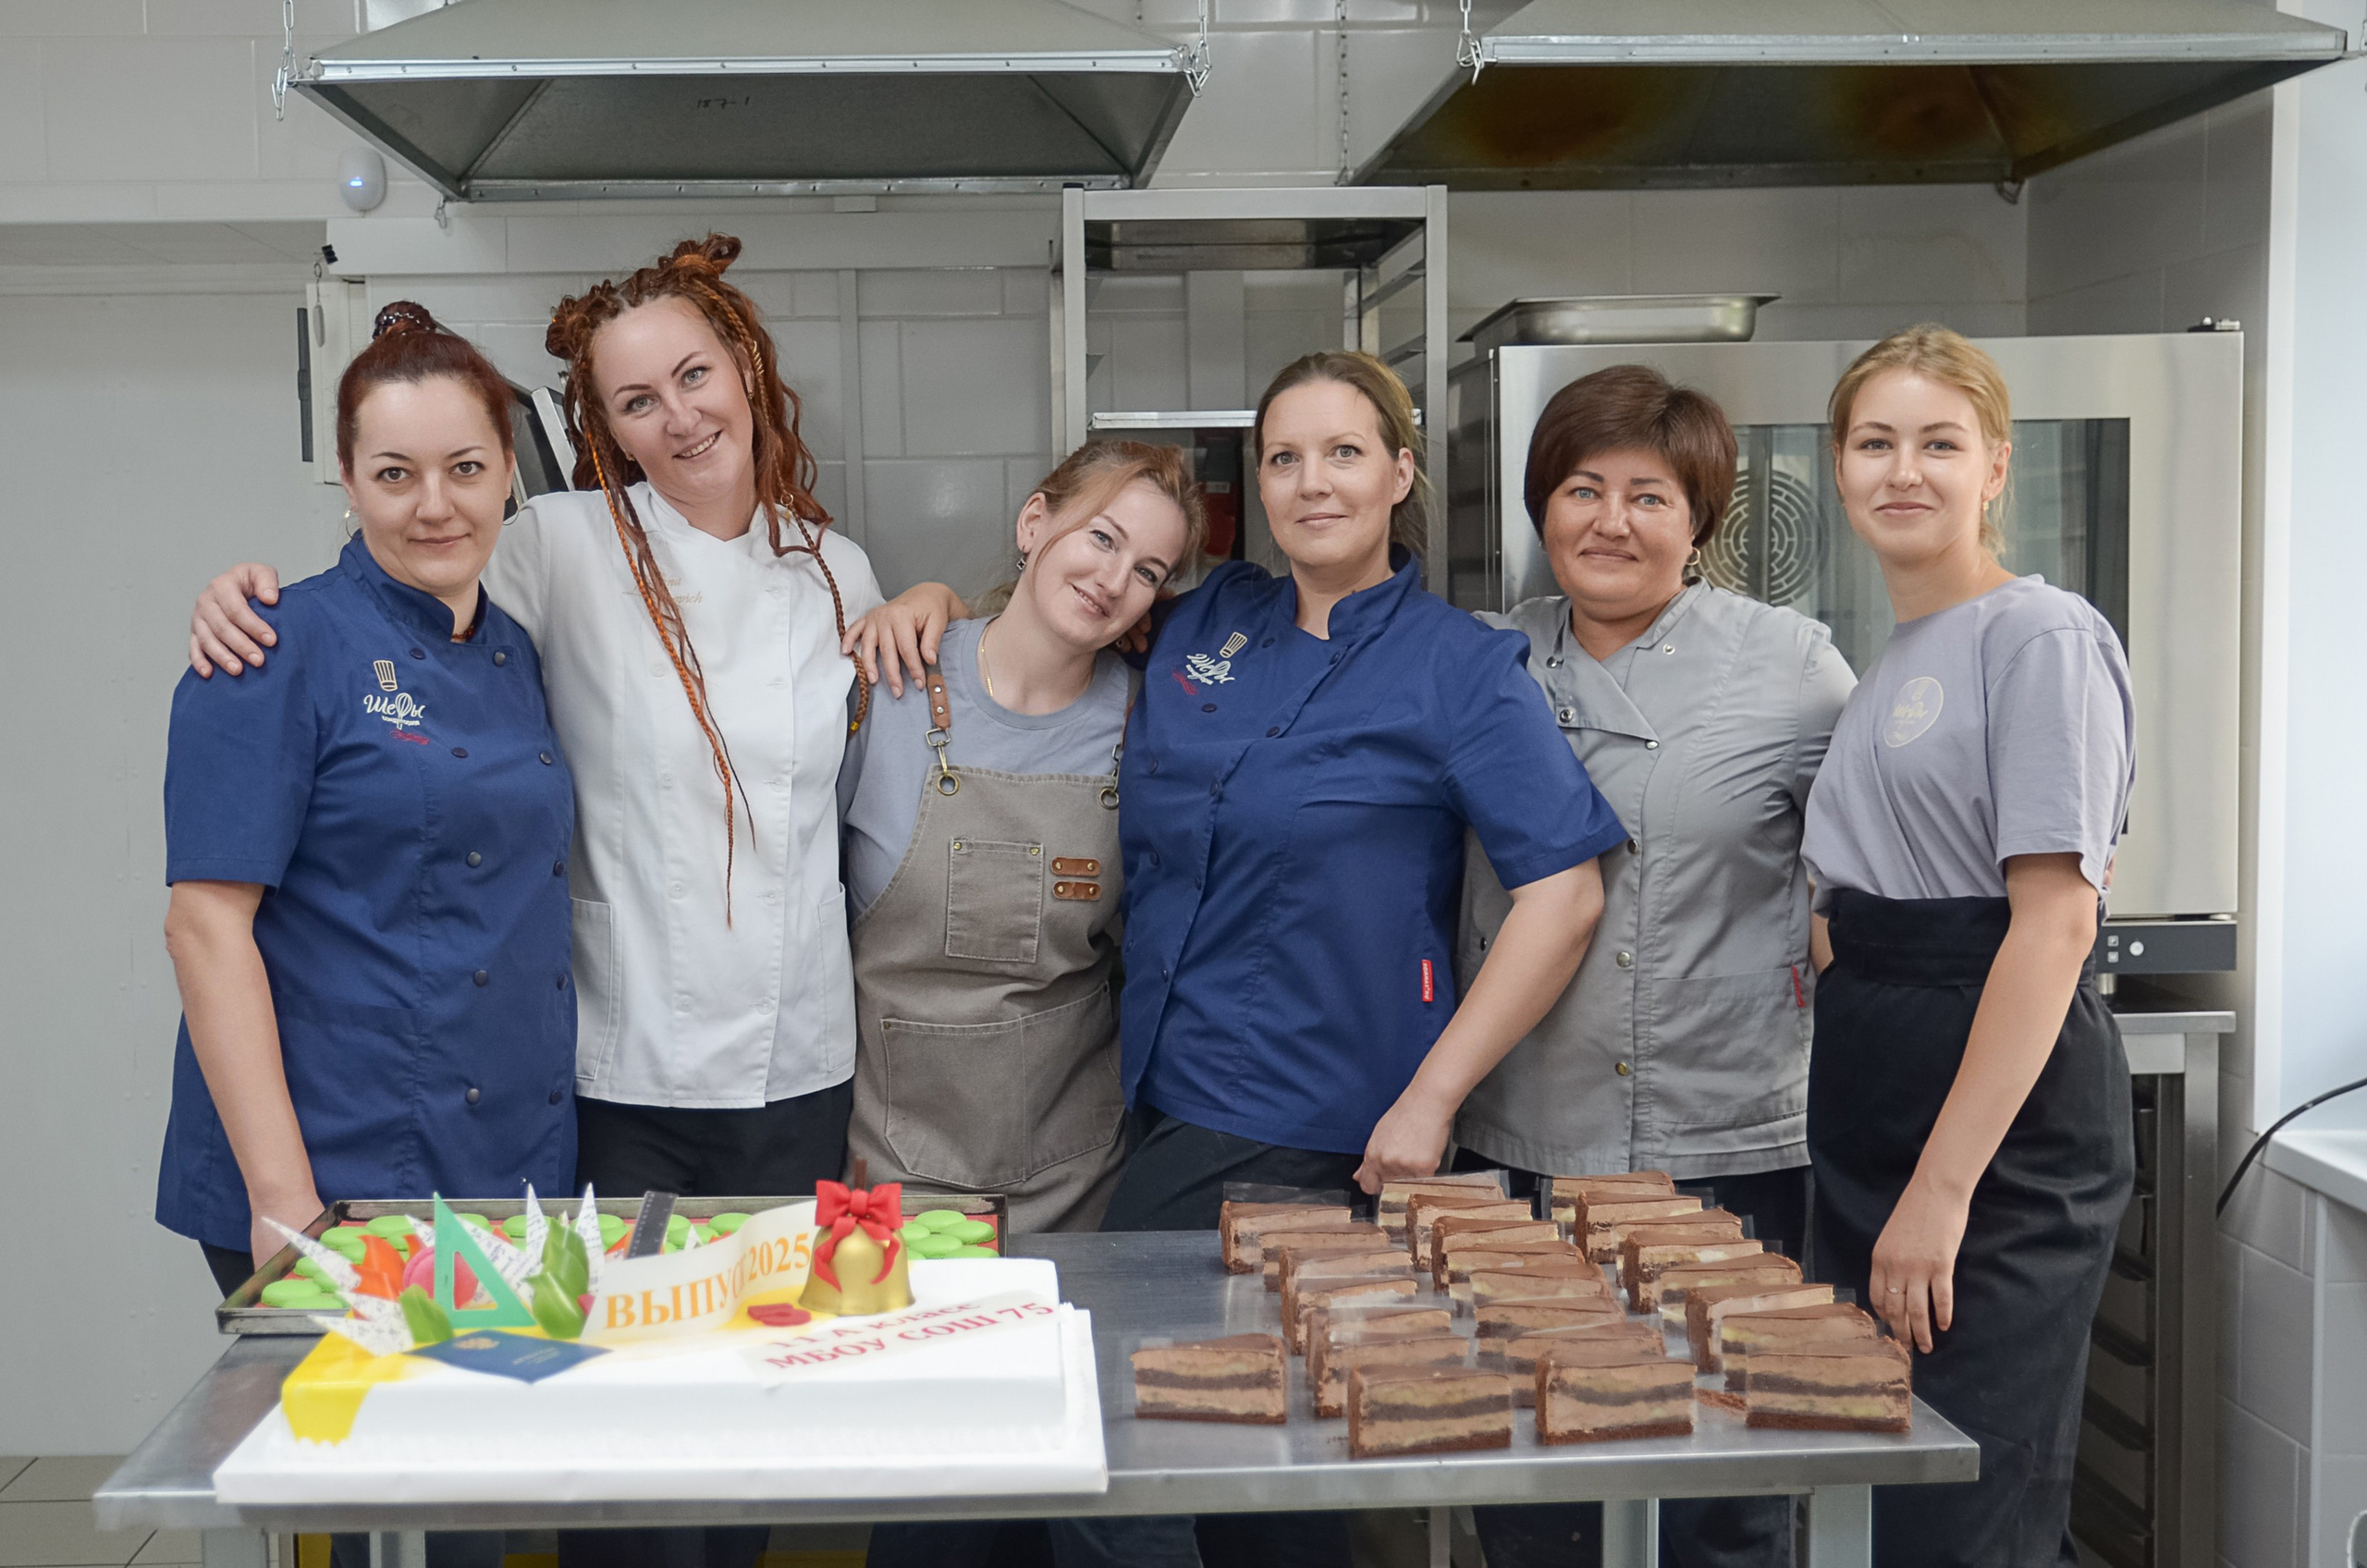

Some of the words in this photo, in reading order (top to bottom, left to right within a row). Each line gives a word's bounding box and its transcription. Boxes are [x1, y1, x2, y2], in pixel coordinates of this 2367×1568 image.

[748, 1232, 811, 1281] 2025
[765, 1338, 886, 1369] МБОУ
[897, 1315, 1000, 1341] СОШ
[996, 1303, 1054, 1319] 75
